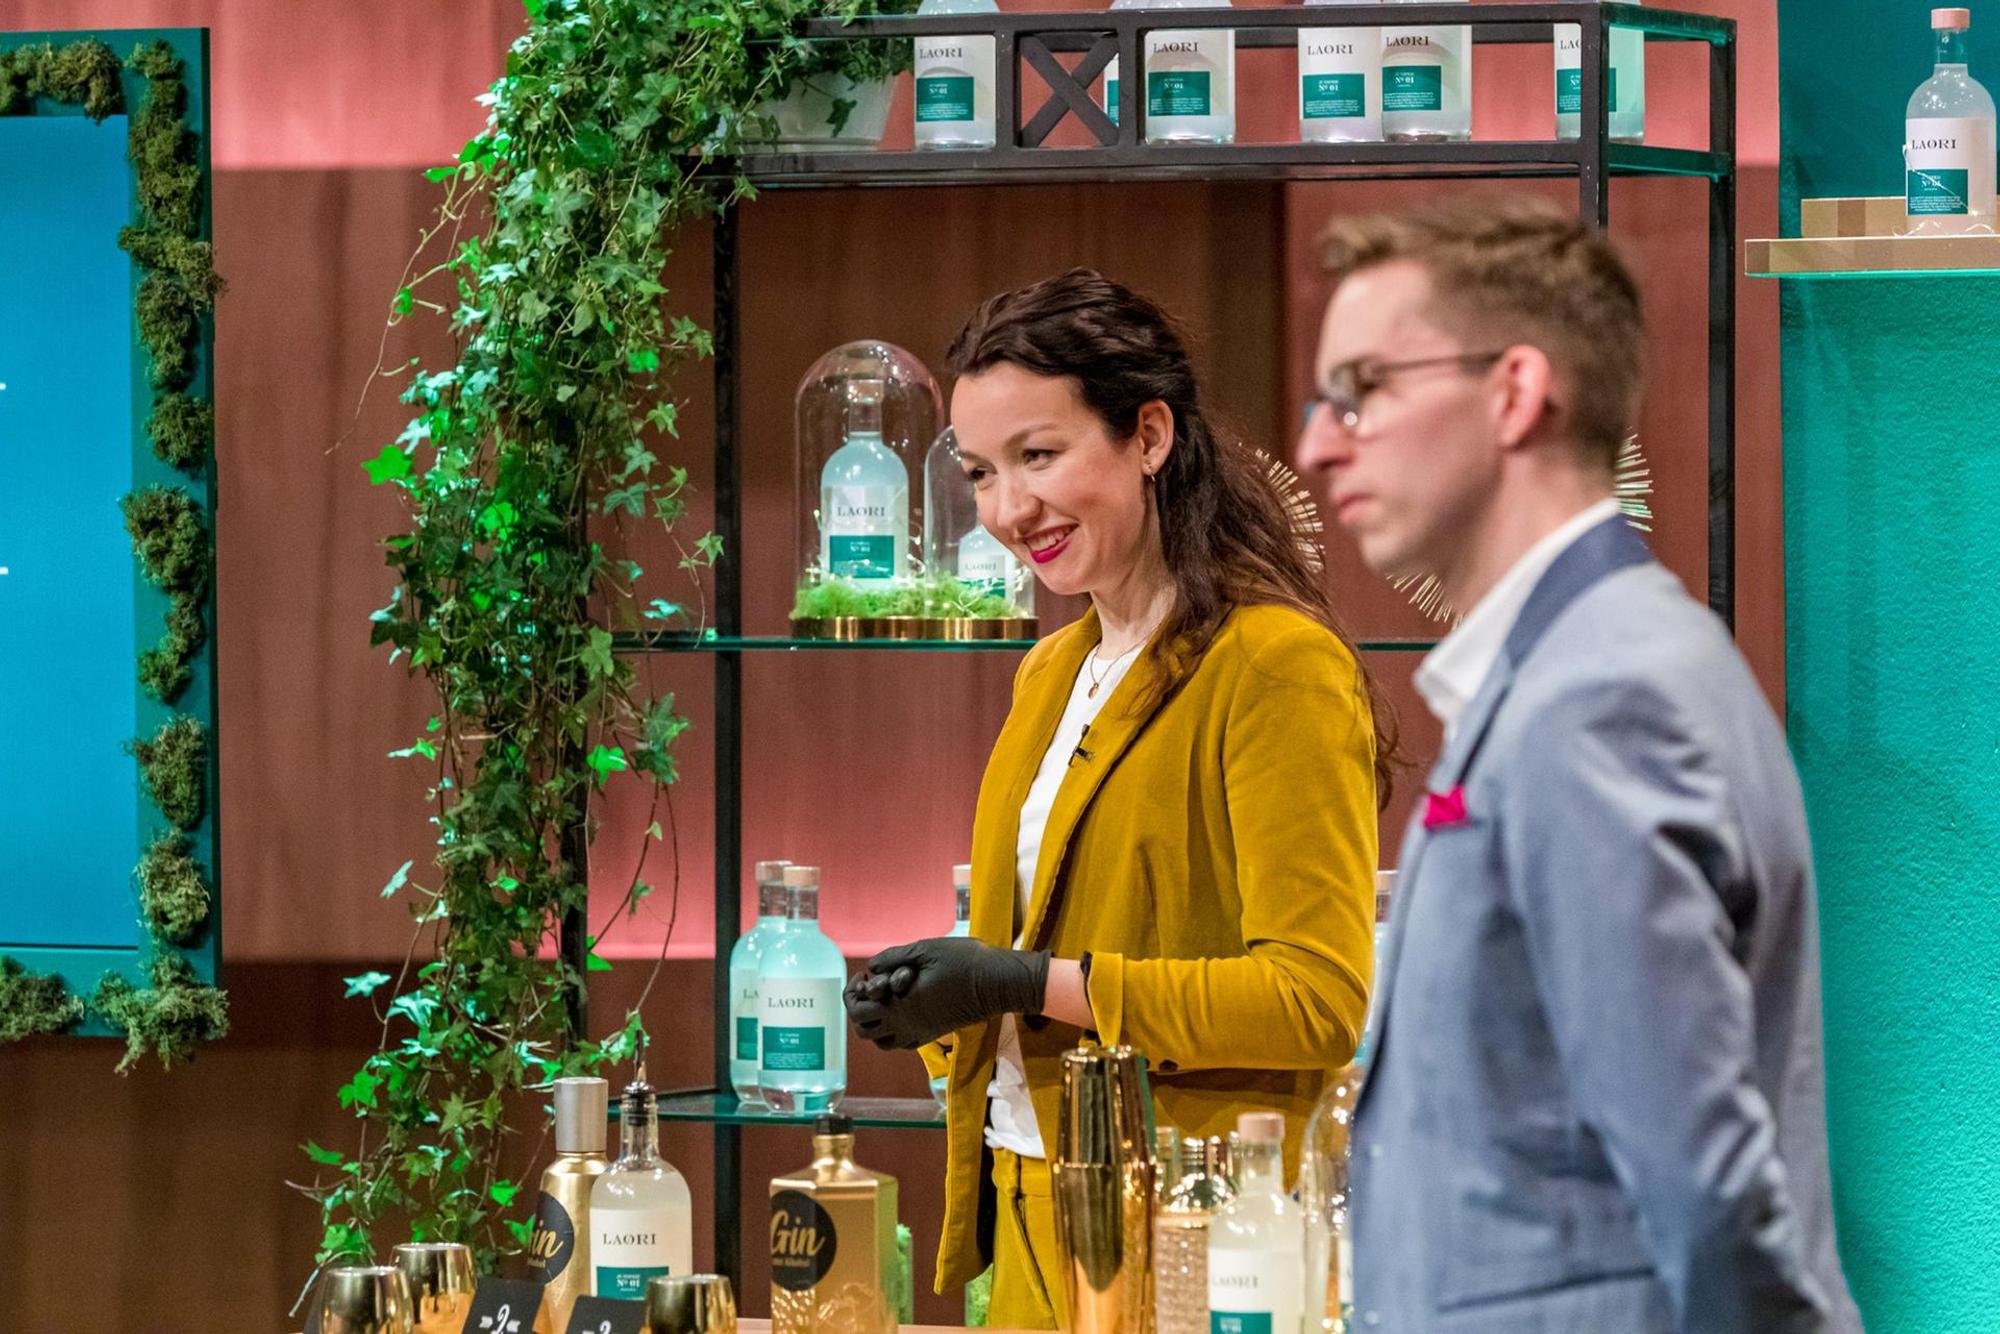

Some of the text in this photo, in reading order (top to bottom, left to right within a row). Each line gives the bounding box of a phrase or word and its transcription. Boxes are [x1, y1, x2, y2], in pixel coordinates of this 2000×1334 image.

[1153, 42, 1198, 53] LAORI
[1386, 36, 1430, 48] LAORI
[919, 48, 962, 59] LAORI
[1307, 44, 1353, 56] LAORI
[1912, 138, 1956, 150] LAORI
[837, 505, 886, 518] LAORI
[767, 997, 814, 1009] LAORI
[602, 1232, 657, 1246] LAORI
[771, 1210, 826, 1256] Gin
